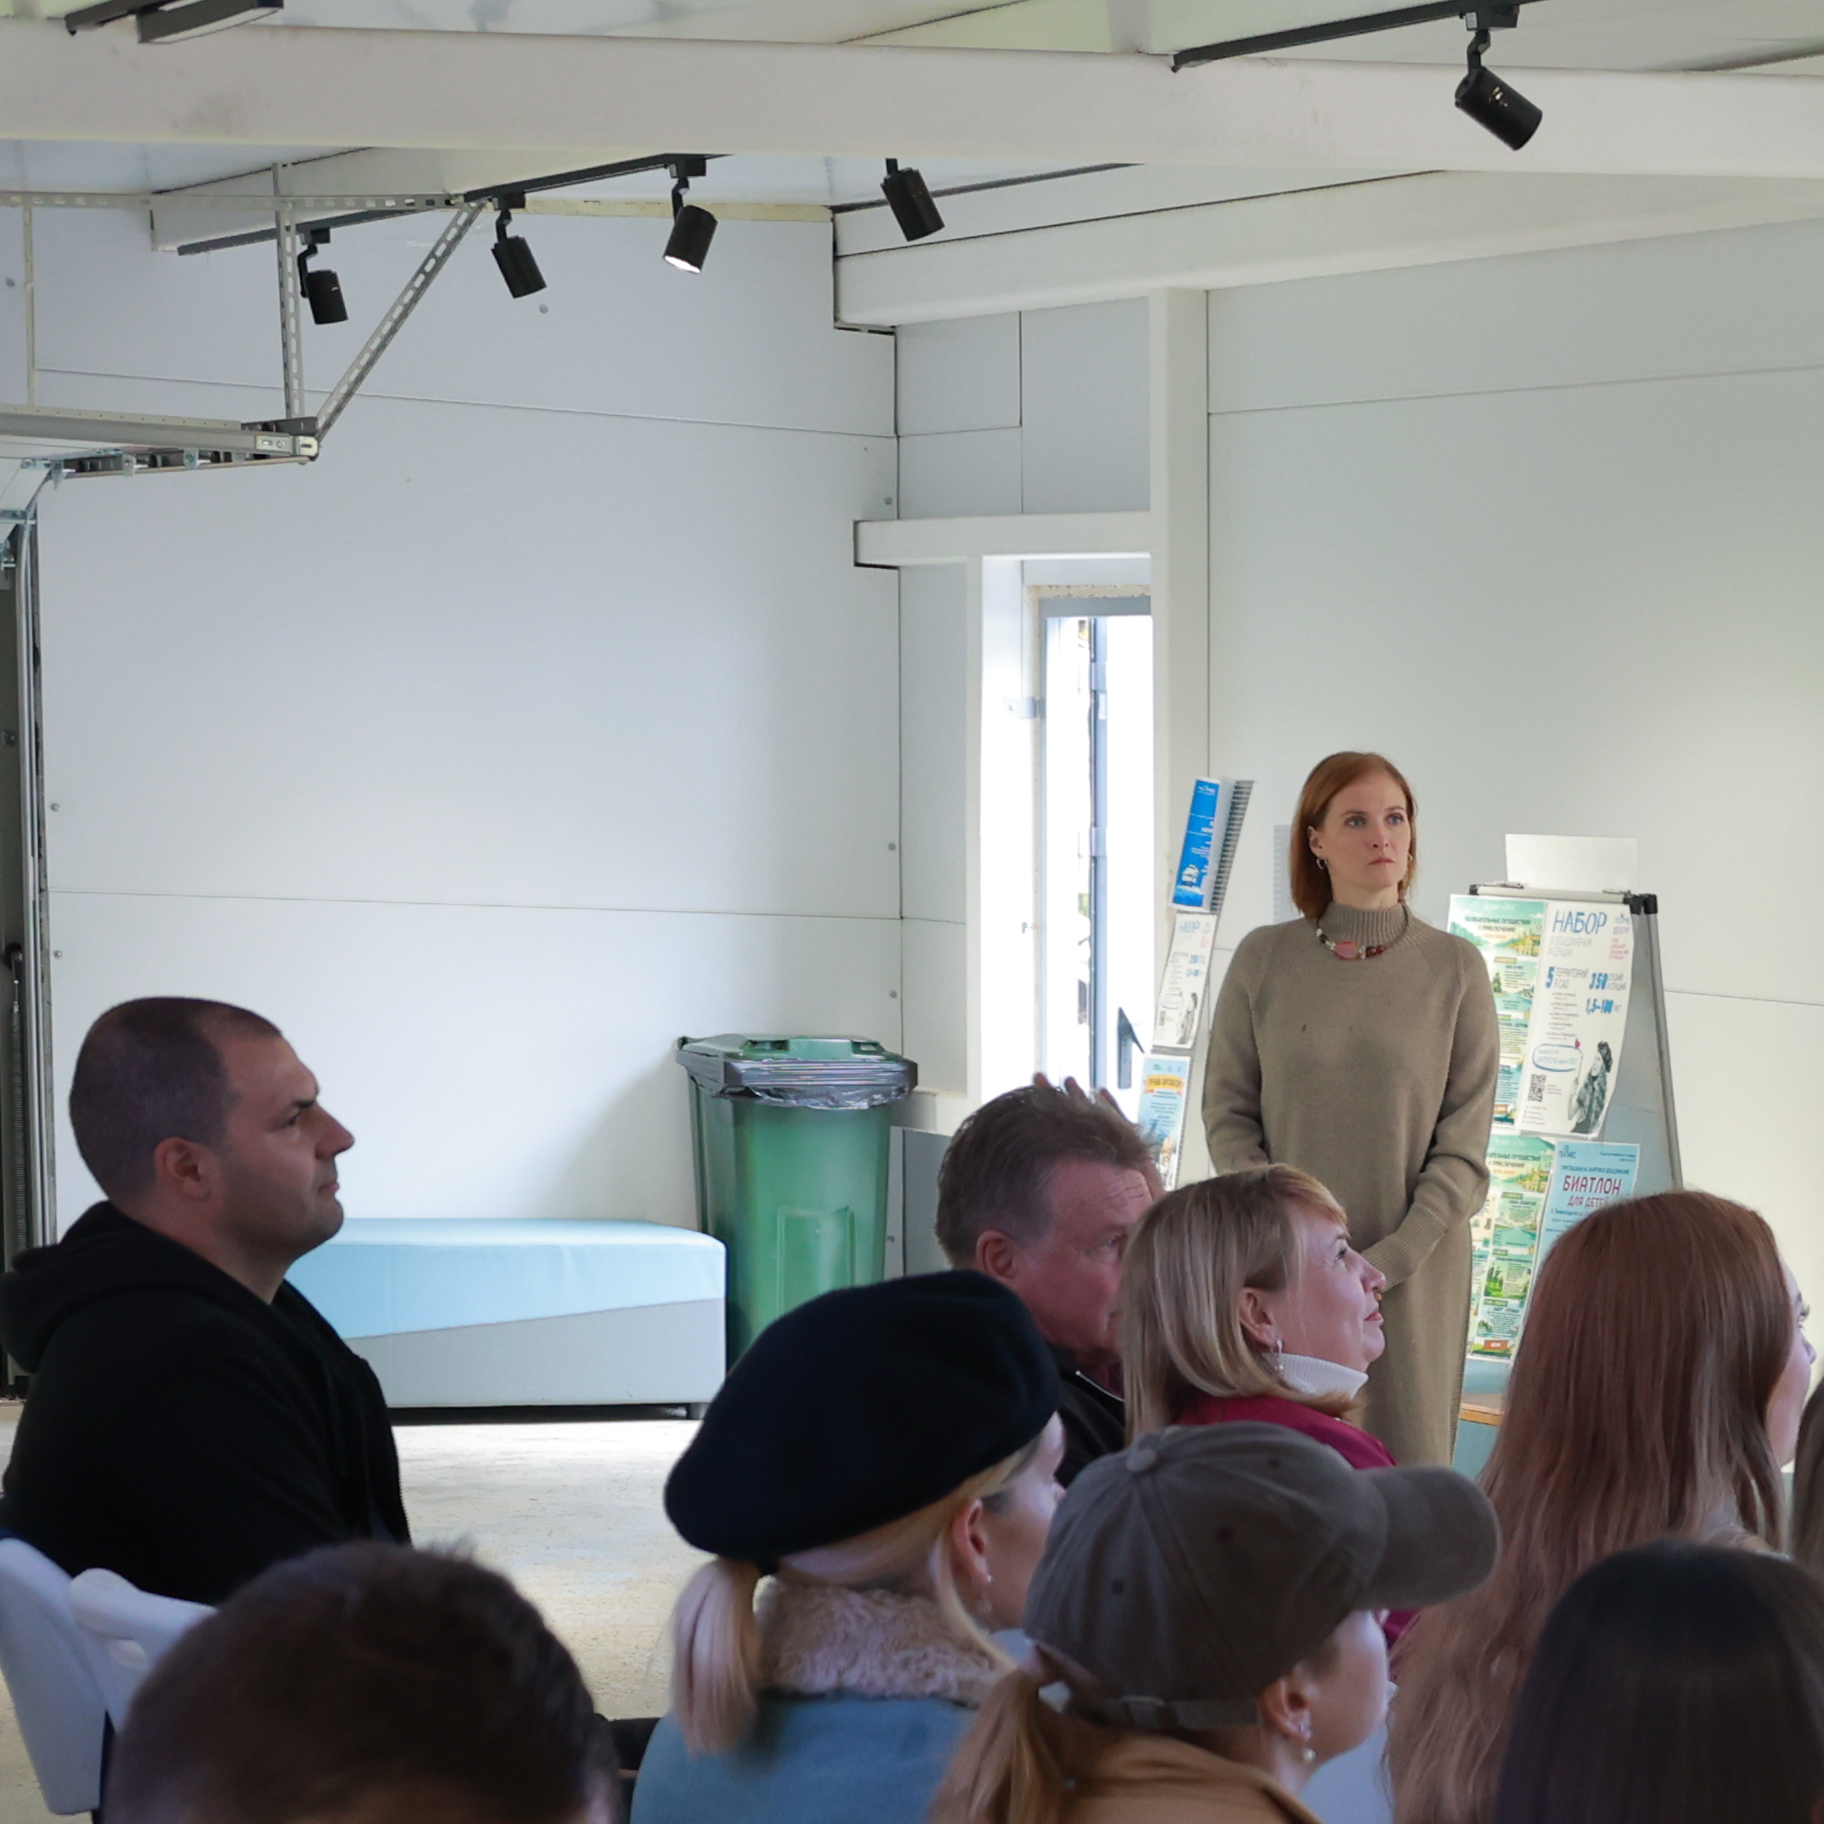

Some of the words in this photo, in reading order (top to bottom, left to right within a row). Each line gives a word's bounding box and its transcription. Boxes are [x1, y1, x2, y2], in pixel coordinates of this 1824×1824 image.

[1552, 910, 1607, 934] НАБОР
[1545, 966, 1555, 988] 5
[1562, 1175, 1622, 1195] БИАТЛОН
